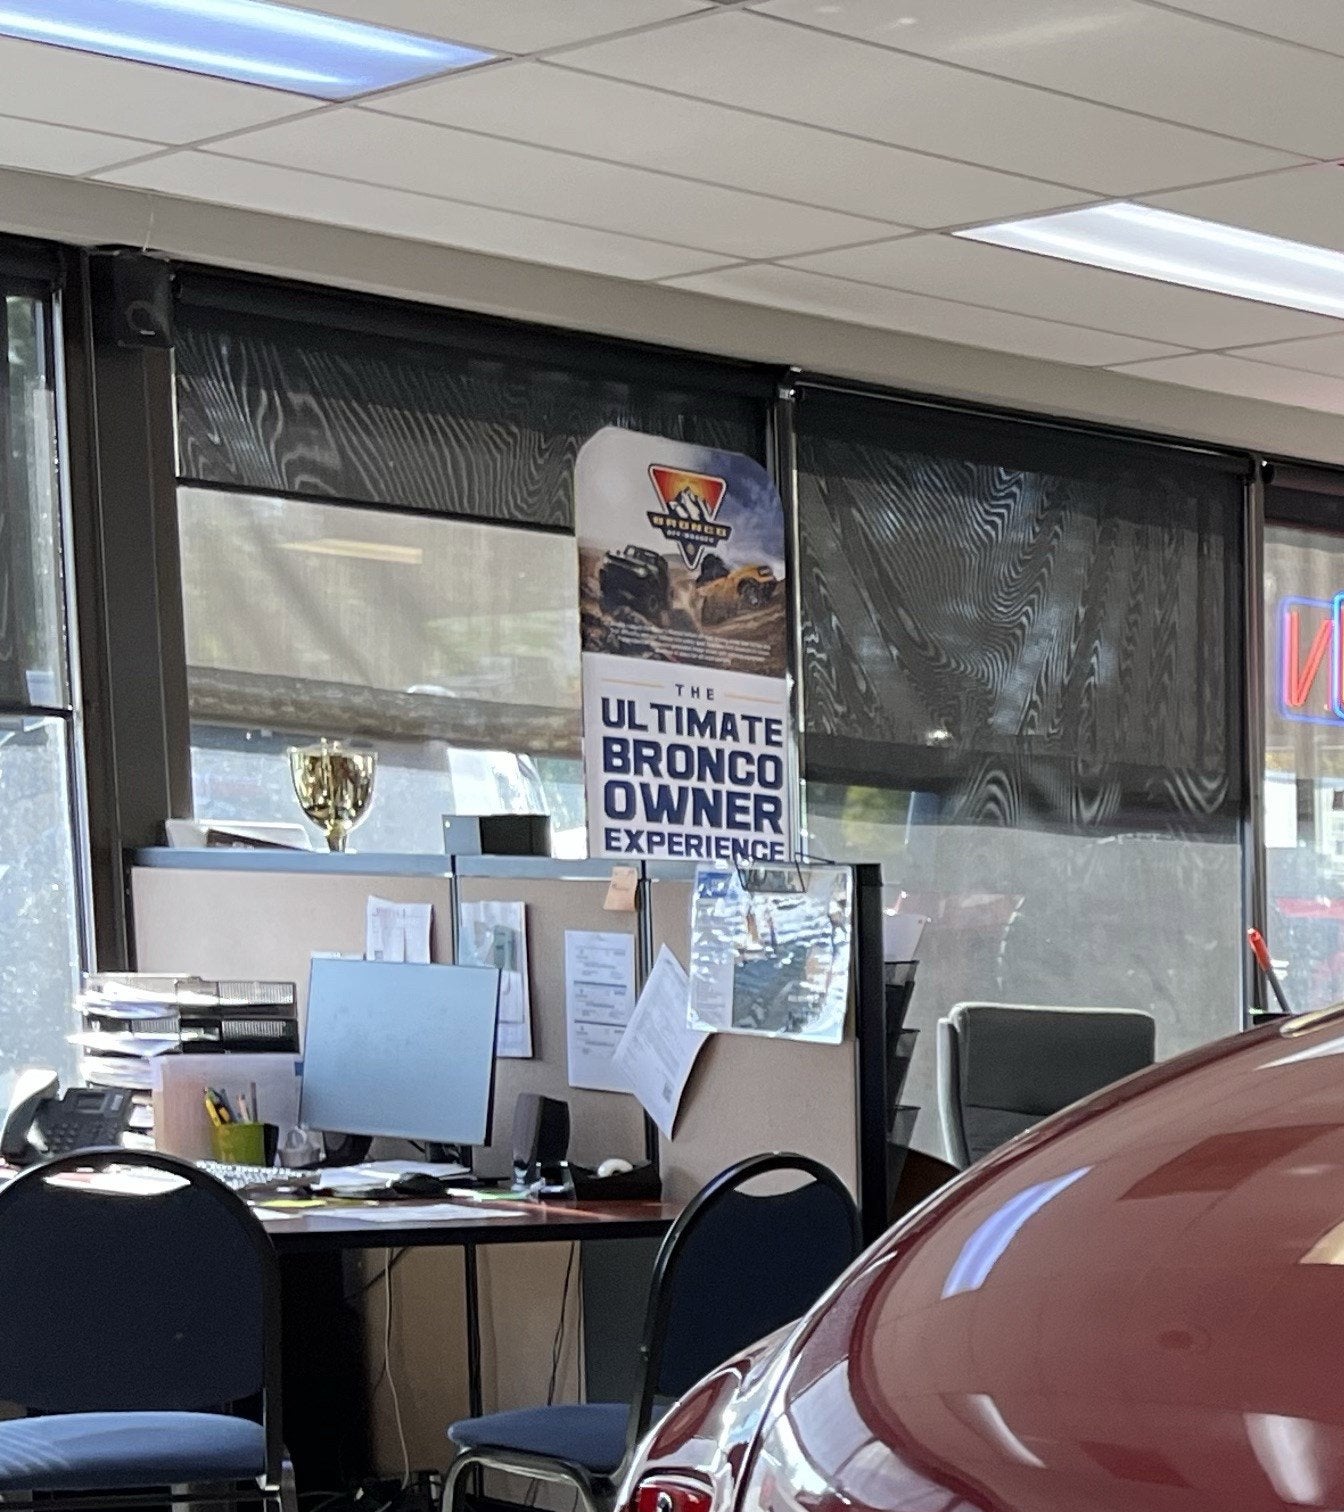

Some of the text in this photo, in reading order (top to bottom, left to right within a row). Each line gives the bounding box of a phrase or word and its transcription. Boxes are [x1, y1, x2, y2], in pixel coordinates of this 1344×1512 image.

[652, 516, 727, 537] BRONCO
[675, 684, 715, 700] THE
[601, 696, 783, 747] ULTIMATE
[603, 736, 783, 790] BRONCO
[604, 780, 784, 835] OWNER
[604, 827, 785, 862] EXPERIENCE
